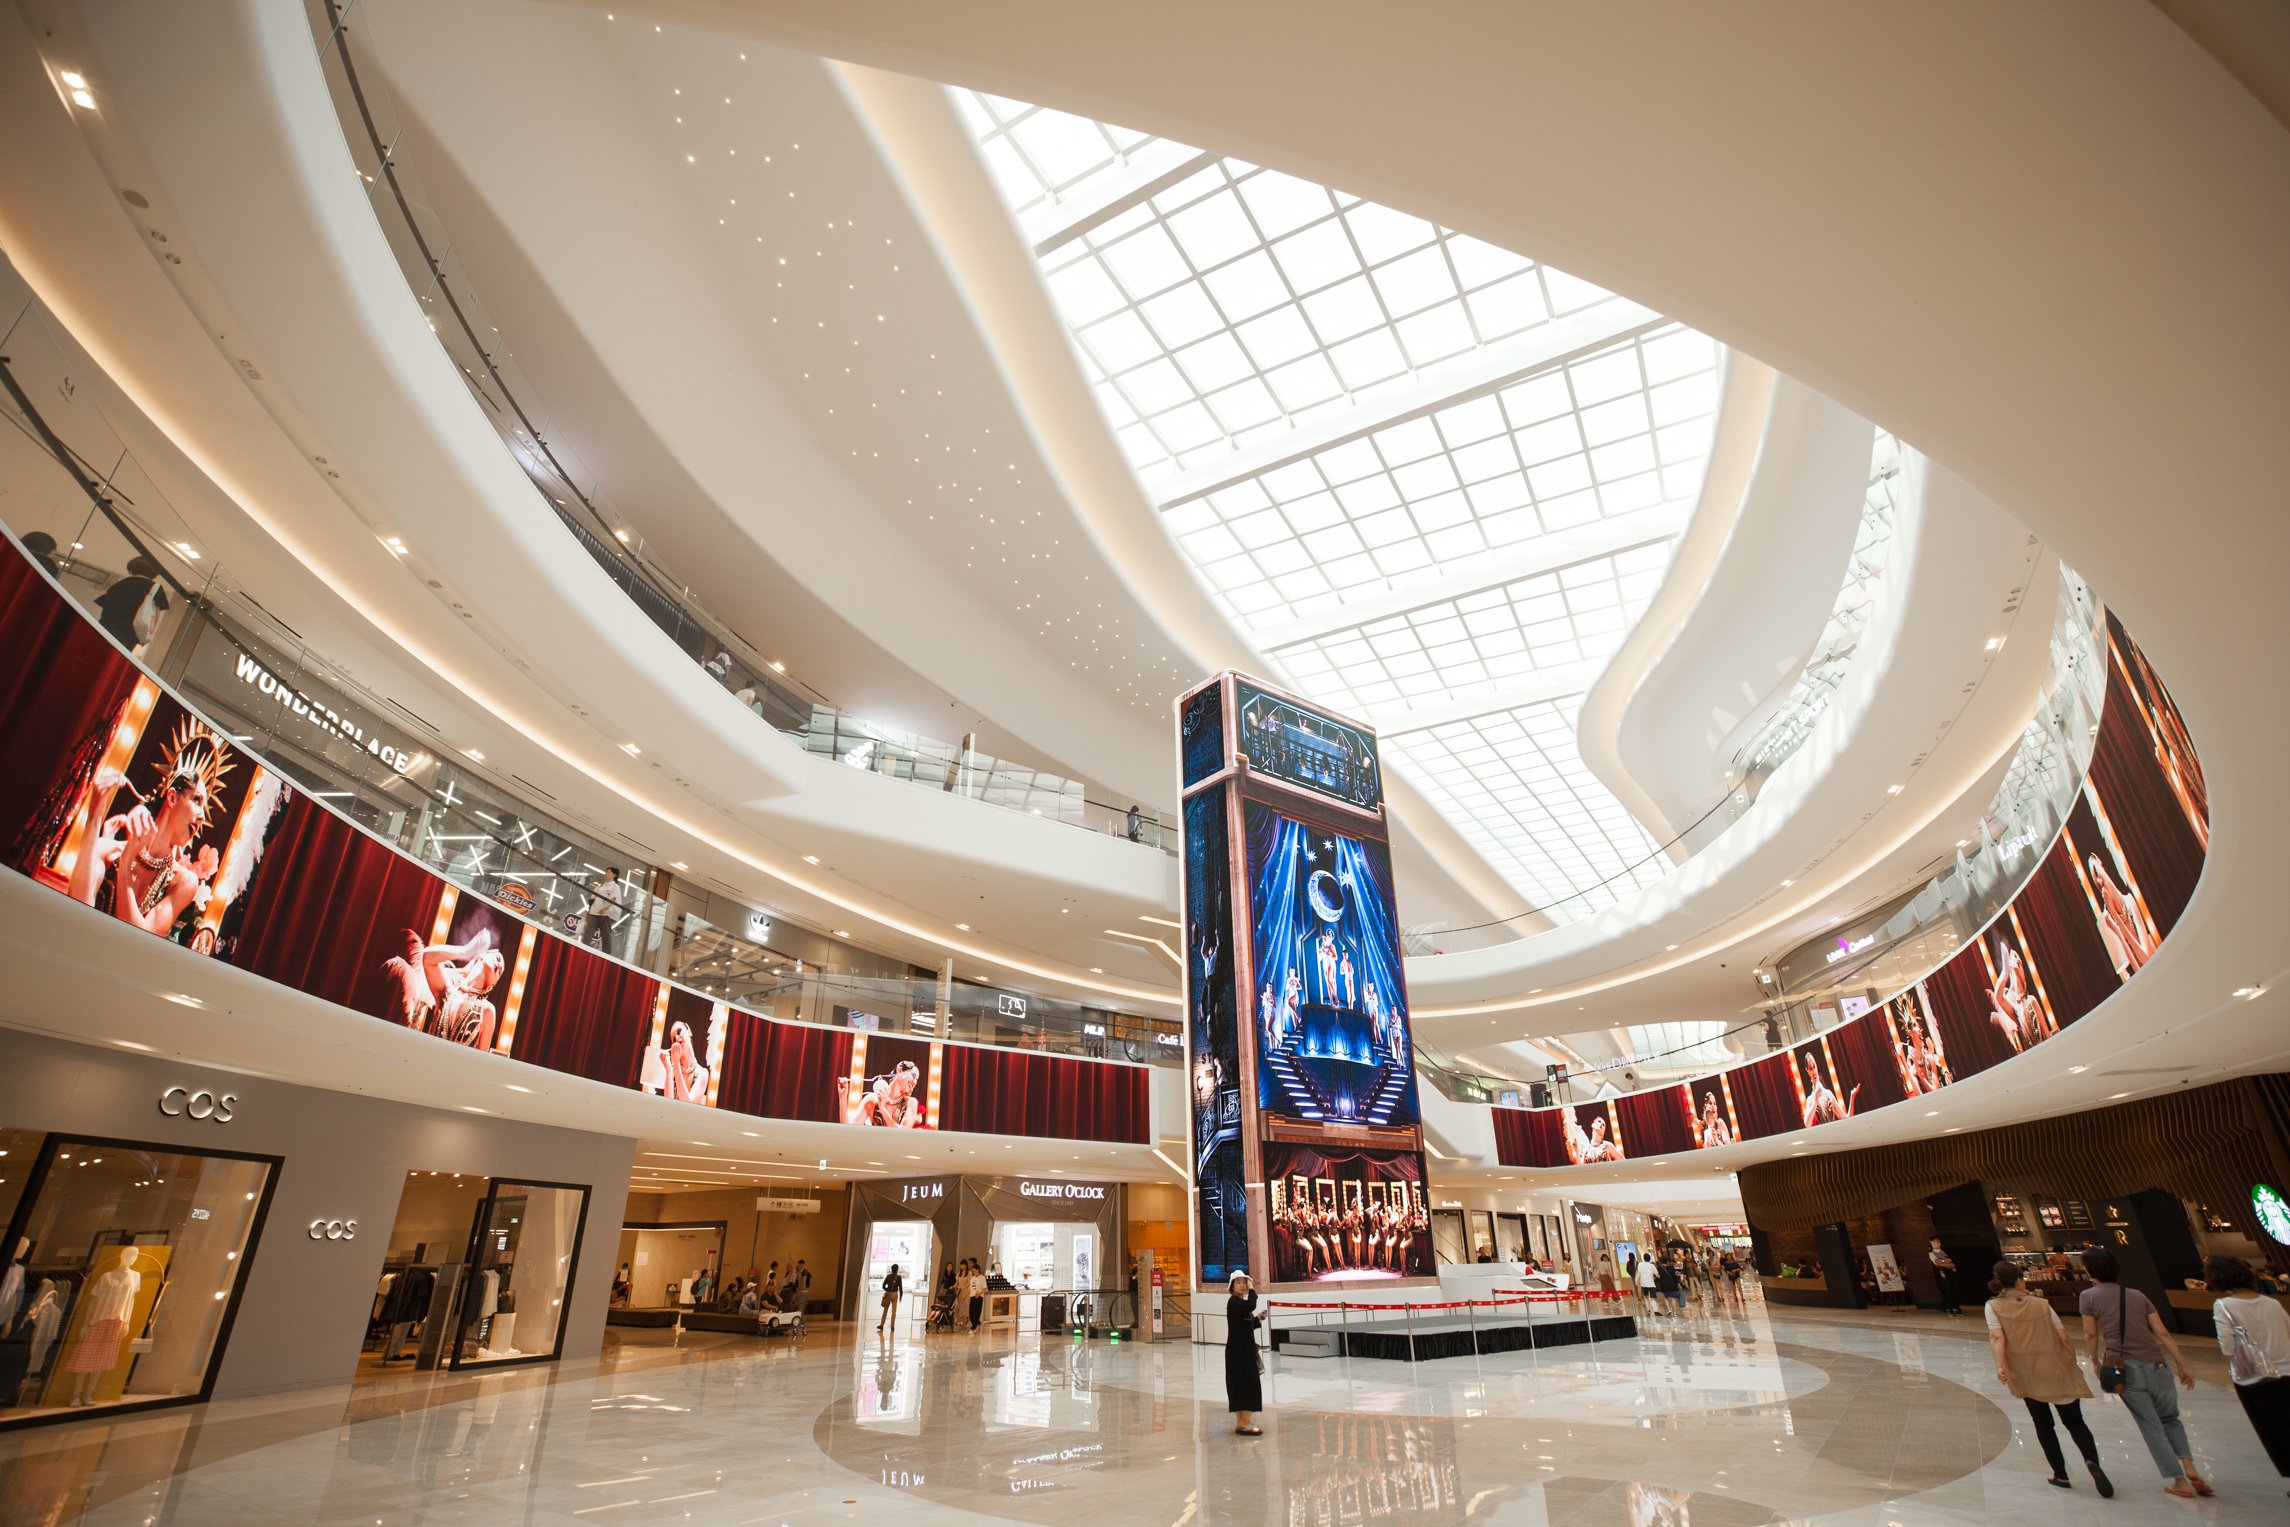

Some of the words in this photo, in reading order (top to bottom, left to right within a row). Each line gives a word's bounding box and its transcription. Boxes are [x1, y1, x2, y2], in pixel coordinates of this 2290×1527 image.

[235, 653, 409, 773] WONDERPLACE
[1997, 824, 2039, 861] Lipault
[498, 889, 533, 910] Dickies
[1158, 1033, 1178, 1046] Café
[159, 1087, 237, 1123] COS
[902, 1183, 943, 1202] JEUM
[1020, 1181, 1065, 1198] GALLERY
[1066, 1184, 1104, 1200] O'CLOCK
[309, 1220, 357, 1240] COS
